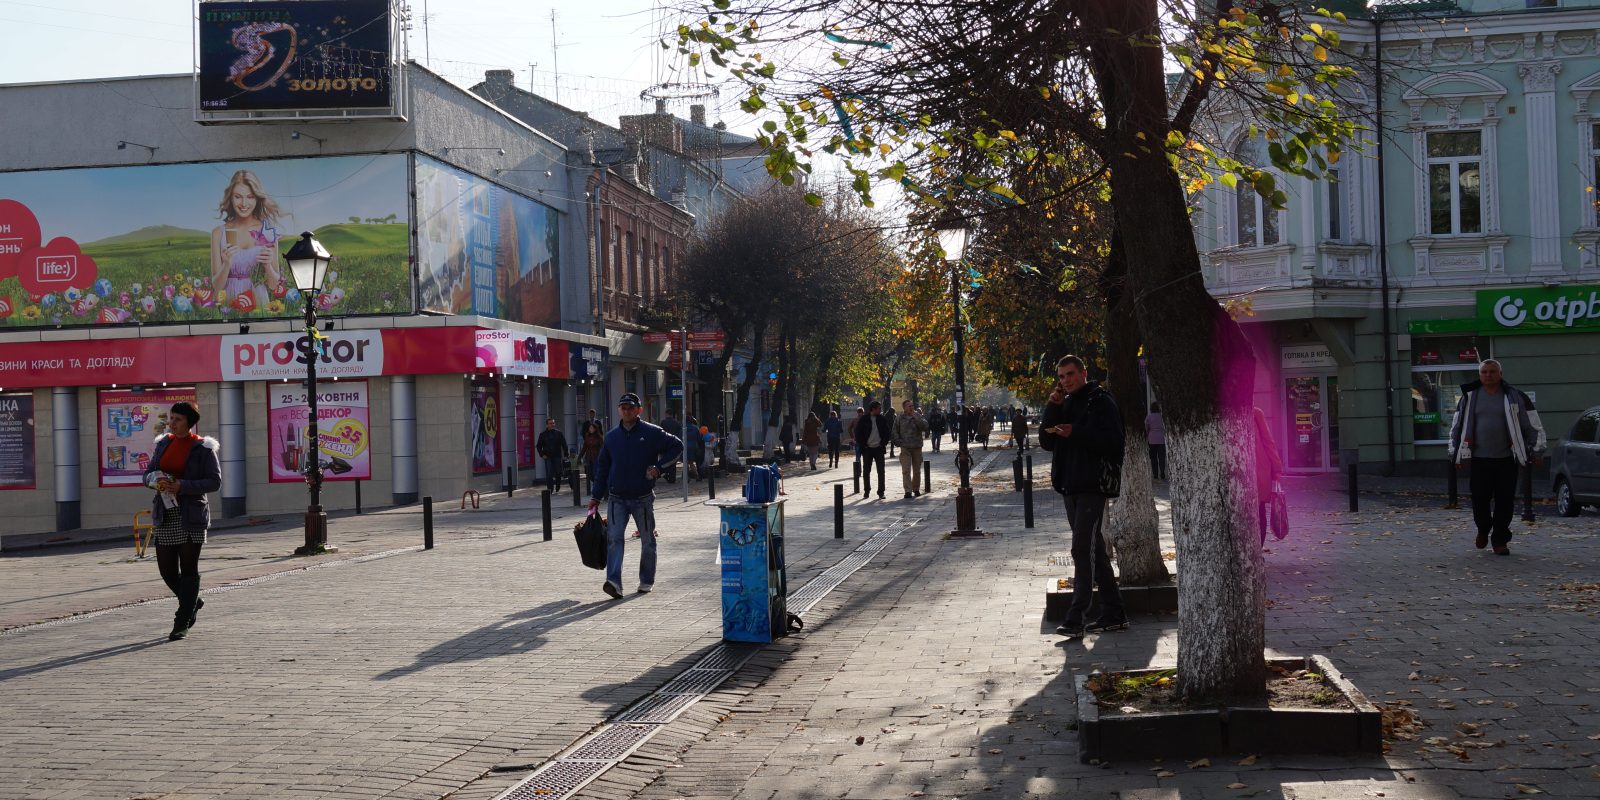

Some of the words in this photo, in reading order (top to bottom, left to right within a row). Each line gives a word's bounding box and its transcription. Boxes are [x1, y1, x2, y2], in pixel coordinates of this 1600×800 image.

[287, 77, 377, 92] ЗОЛОТО
[43, 260, 70, 277] life:)
[476, 331, 510, 341] proStor
[233, 336, 370, 375] proStor
[513, 336, 546, 363] roStor
[31, 359, 64, 370] КРАСИ
[69, 358, 82, 368] ТА
[86, 356, 136, 370] ДОГЛЯДУ
[251, 367, 290, 376] МАГАЗИНИ
[330, 365, 364, 375] ДОГЛЯДУ
[281, 394, 293, 404] 25
[301, 394, 309, 403] 2
[290, 409, 309, 420] ВЕС
[318, 407, 352, 420] ДЕКОР
